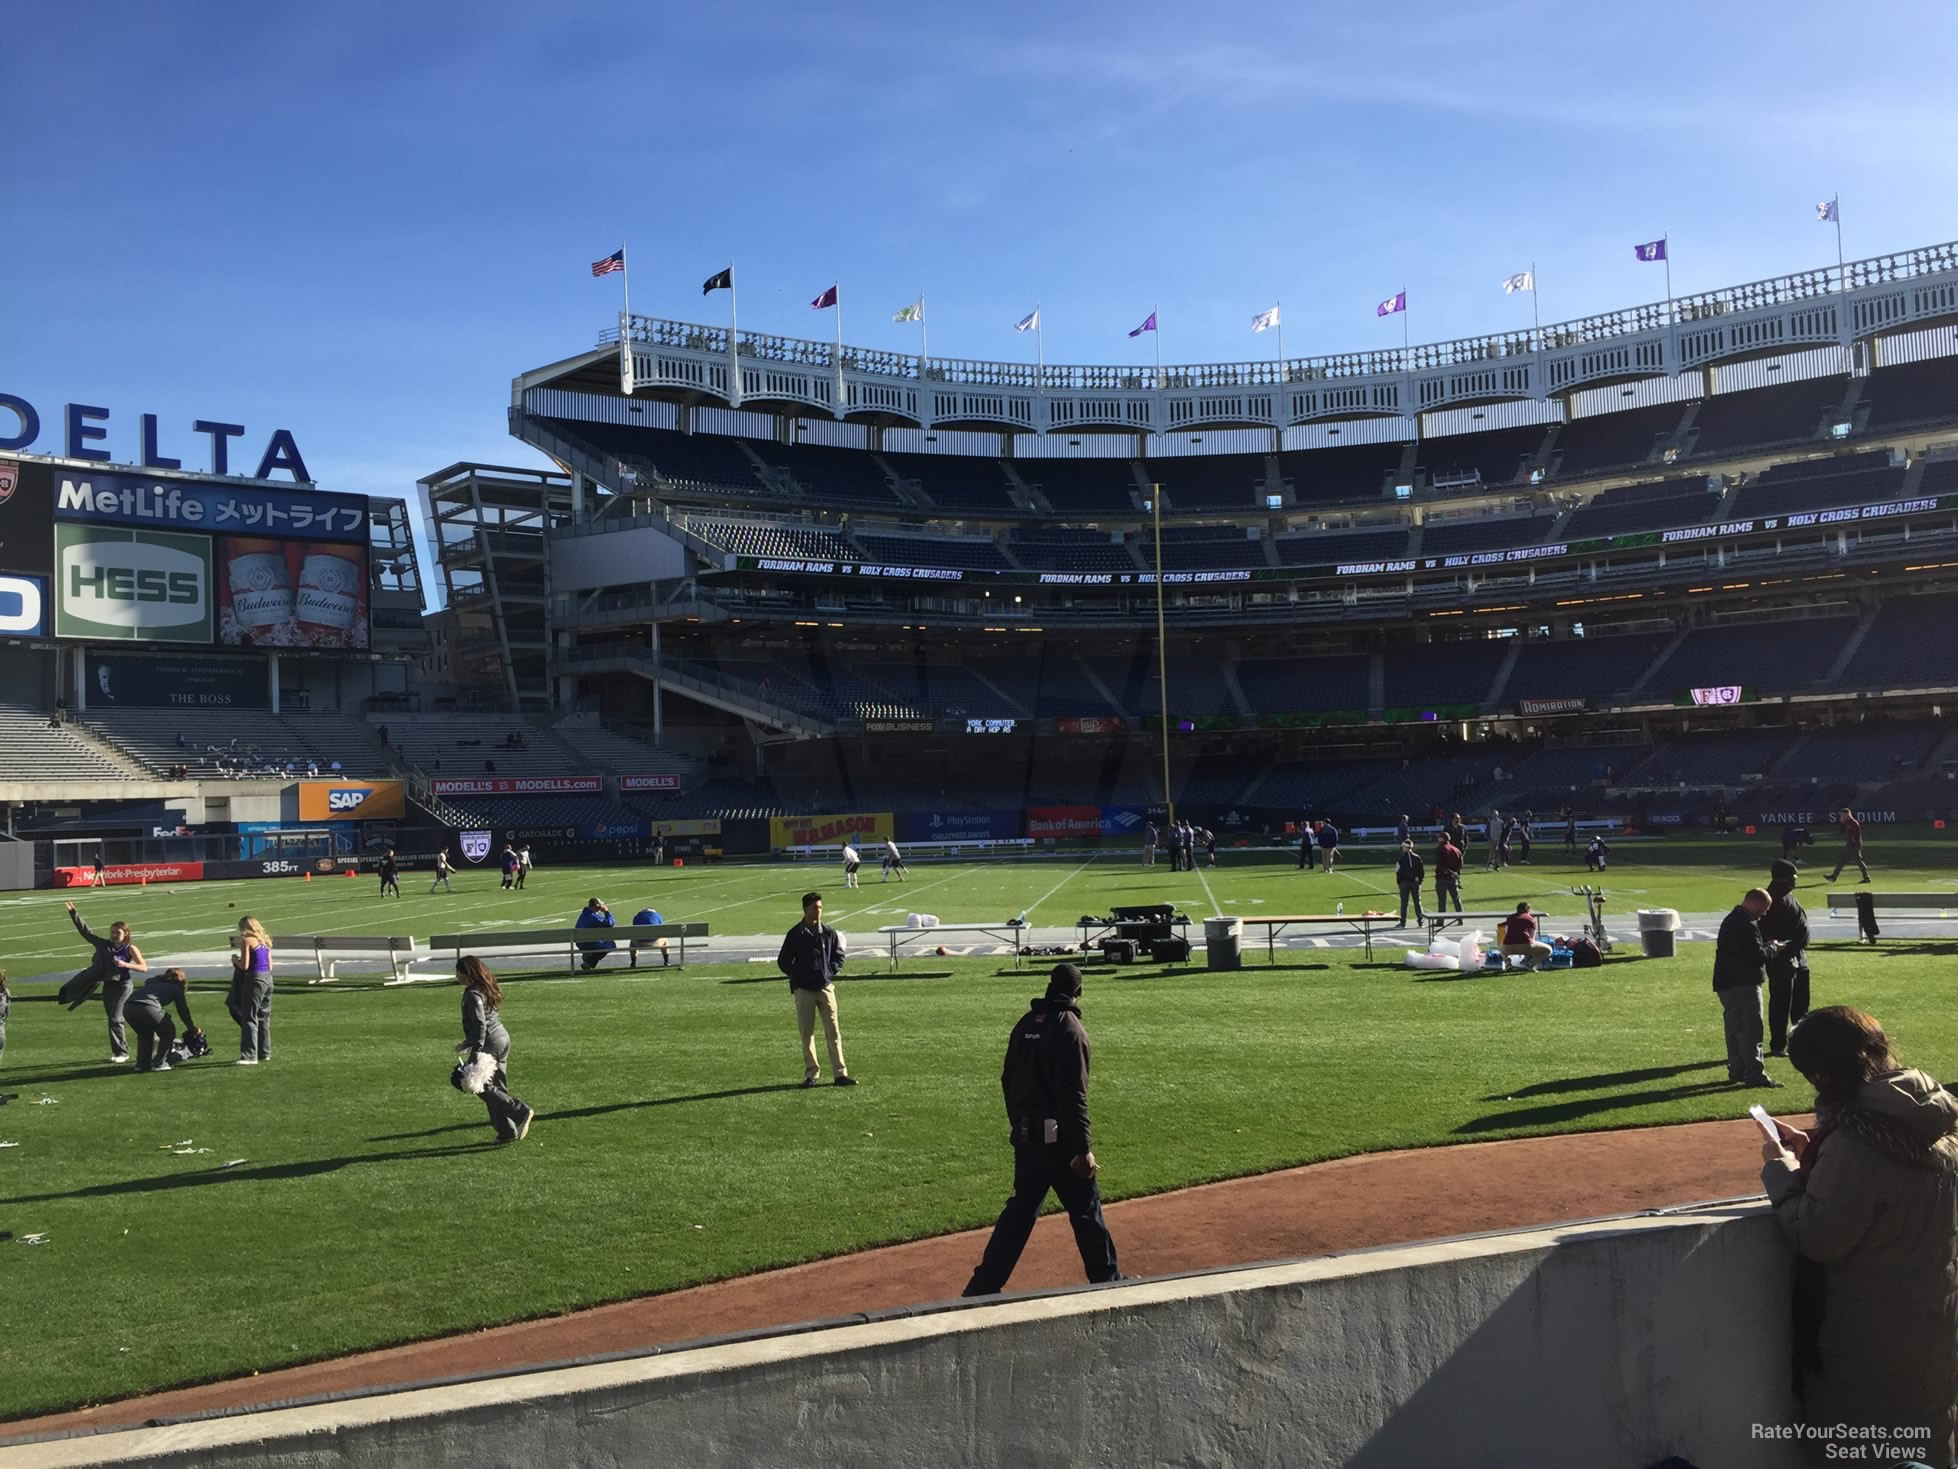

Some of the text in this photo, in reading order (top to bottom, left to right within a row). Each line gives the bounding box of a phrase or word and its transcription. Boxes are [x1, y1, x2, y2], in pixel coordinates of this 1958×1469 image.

[0, 393, 311, 482] DELTA
[58, 480, 204, 521] MetLife
[215, 499, 363, 532] メットライフ
[1662, 526, 1718, 542] FORDHAM
[1719, 521, 1754, 535] RAMS
[1787, 514, 1819, 527] HOLY
[1819, 508, 1860, 522] CROSS
[1861, 498, 1937, 518] CRUSADERS
[1336, 563, 1385, 575] FORDHAM
[1386, 561, 1416, 571] RAMS
[1444, 556, 1471, 567] HOLY
[1471, 552, 1505, 564] CROSS
[1506, 544, 1568, 560] CRUSADERS
[757, 559, 805, 571] FORDHAM
[805, 562, 834, 573] RAMS
[859, 565, 883, 576] HOLY
[883, 566, 912, 577] CROSS
[912, 568, 963, 580] CRUSADERS
[1039, 574, 1083, 583] FORDHAM
[1083, 574, 1112, 583] RAMS
[1162, 573, 1193, 582] CROSS
[1194, 571, 1251, 582] CRUSADERS
[71, 564, 199, 605] HESS
[169, 694, 232, 704] THE BOSS
[1523, 700, 1583, 714] ADMIRATION
[885, 722, 933, 731] BUSINESS
[436, 779, 597, 792] MODELL'S MODELLS.com
[626, 777, 674, 787] MODELL'S
[329, 793, 367, 810] SAP
[946, 815, 991, 827] PlayStation
[1030, 817, 1112, 831] Bank of America
[1760, 812, 1814, 824] YANKEE
[519, 830, 563, 838] GATORADE
[609, 824, 638, 835] pepsi
